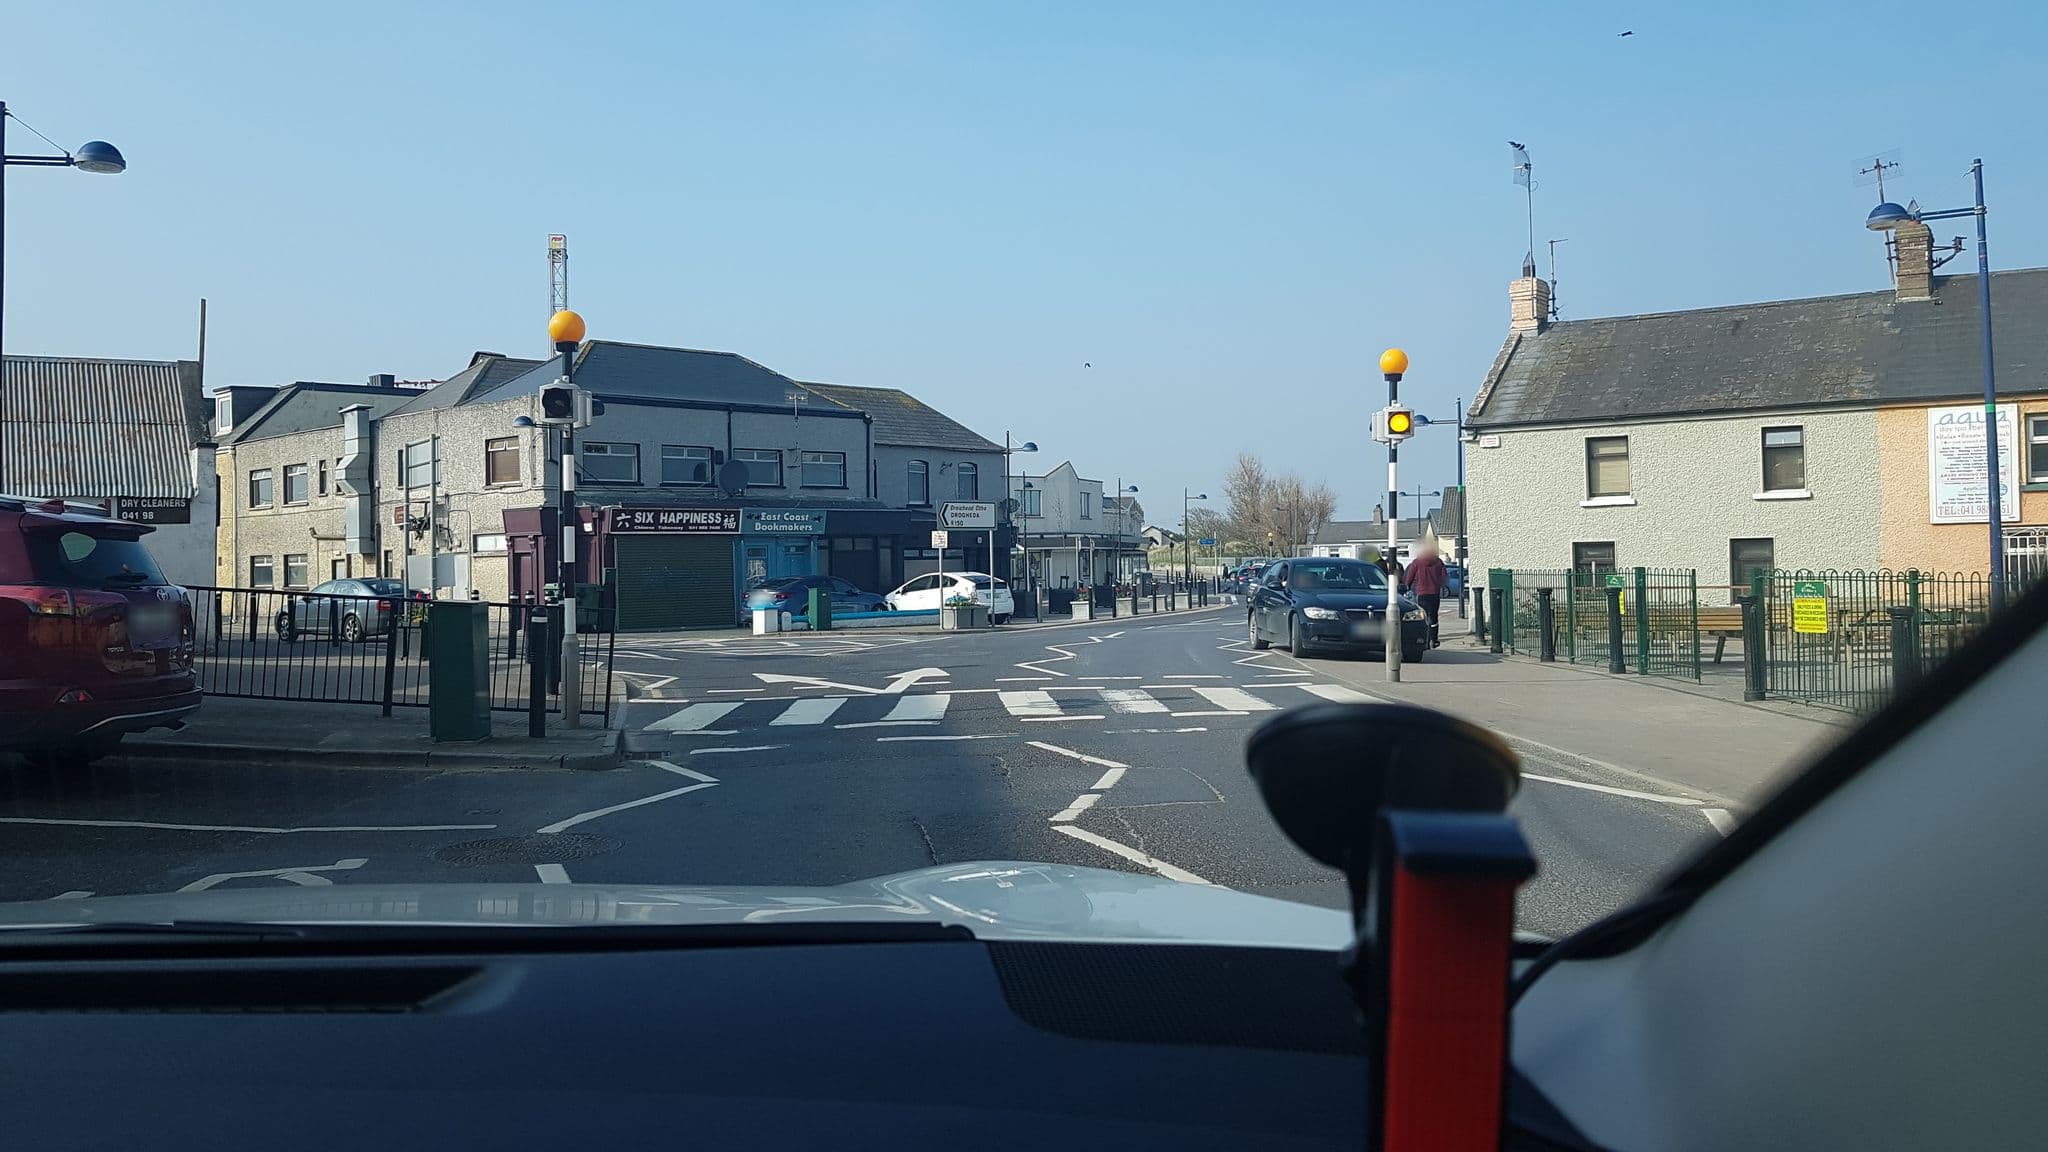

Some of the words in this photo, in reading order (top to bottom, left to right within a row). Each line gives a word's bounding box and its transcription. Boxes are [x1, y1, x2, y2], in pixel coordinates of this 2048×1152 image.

[121, 499, 138, 507] DRY
[141, 499, 186, 508] CLEANERS
[121, 511, 139, 519] 041
[634, 511, 655, 523] SIX
[660, 512, 722, 524] HAPPINESS
[760, 512, 781, 521] East
[783, 512, 809, 521] Coast
[616, 512, 632, 528] 六
[754, 522, 813, 531] Bookmakers
